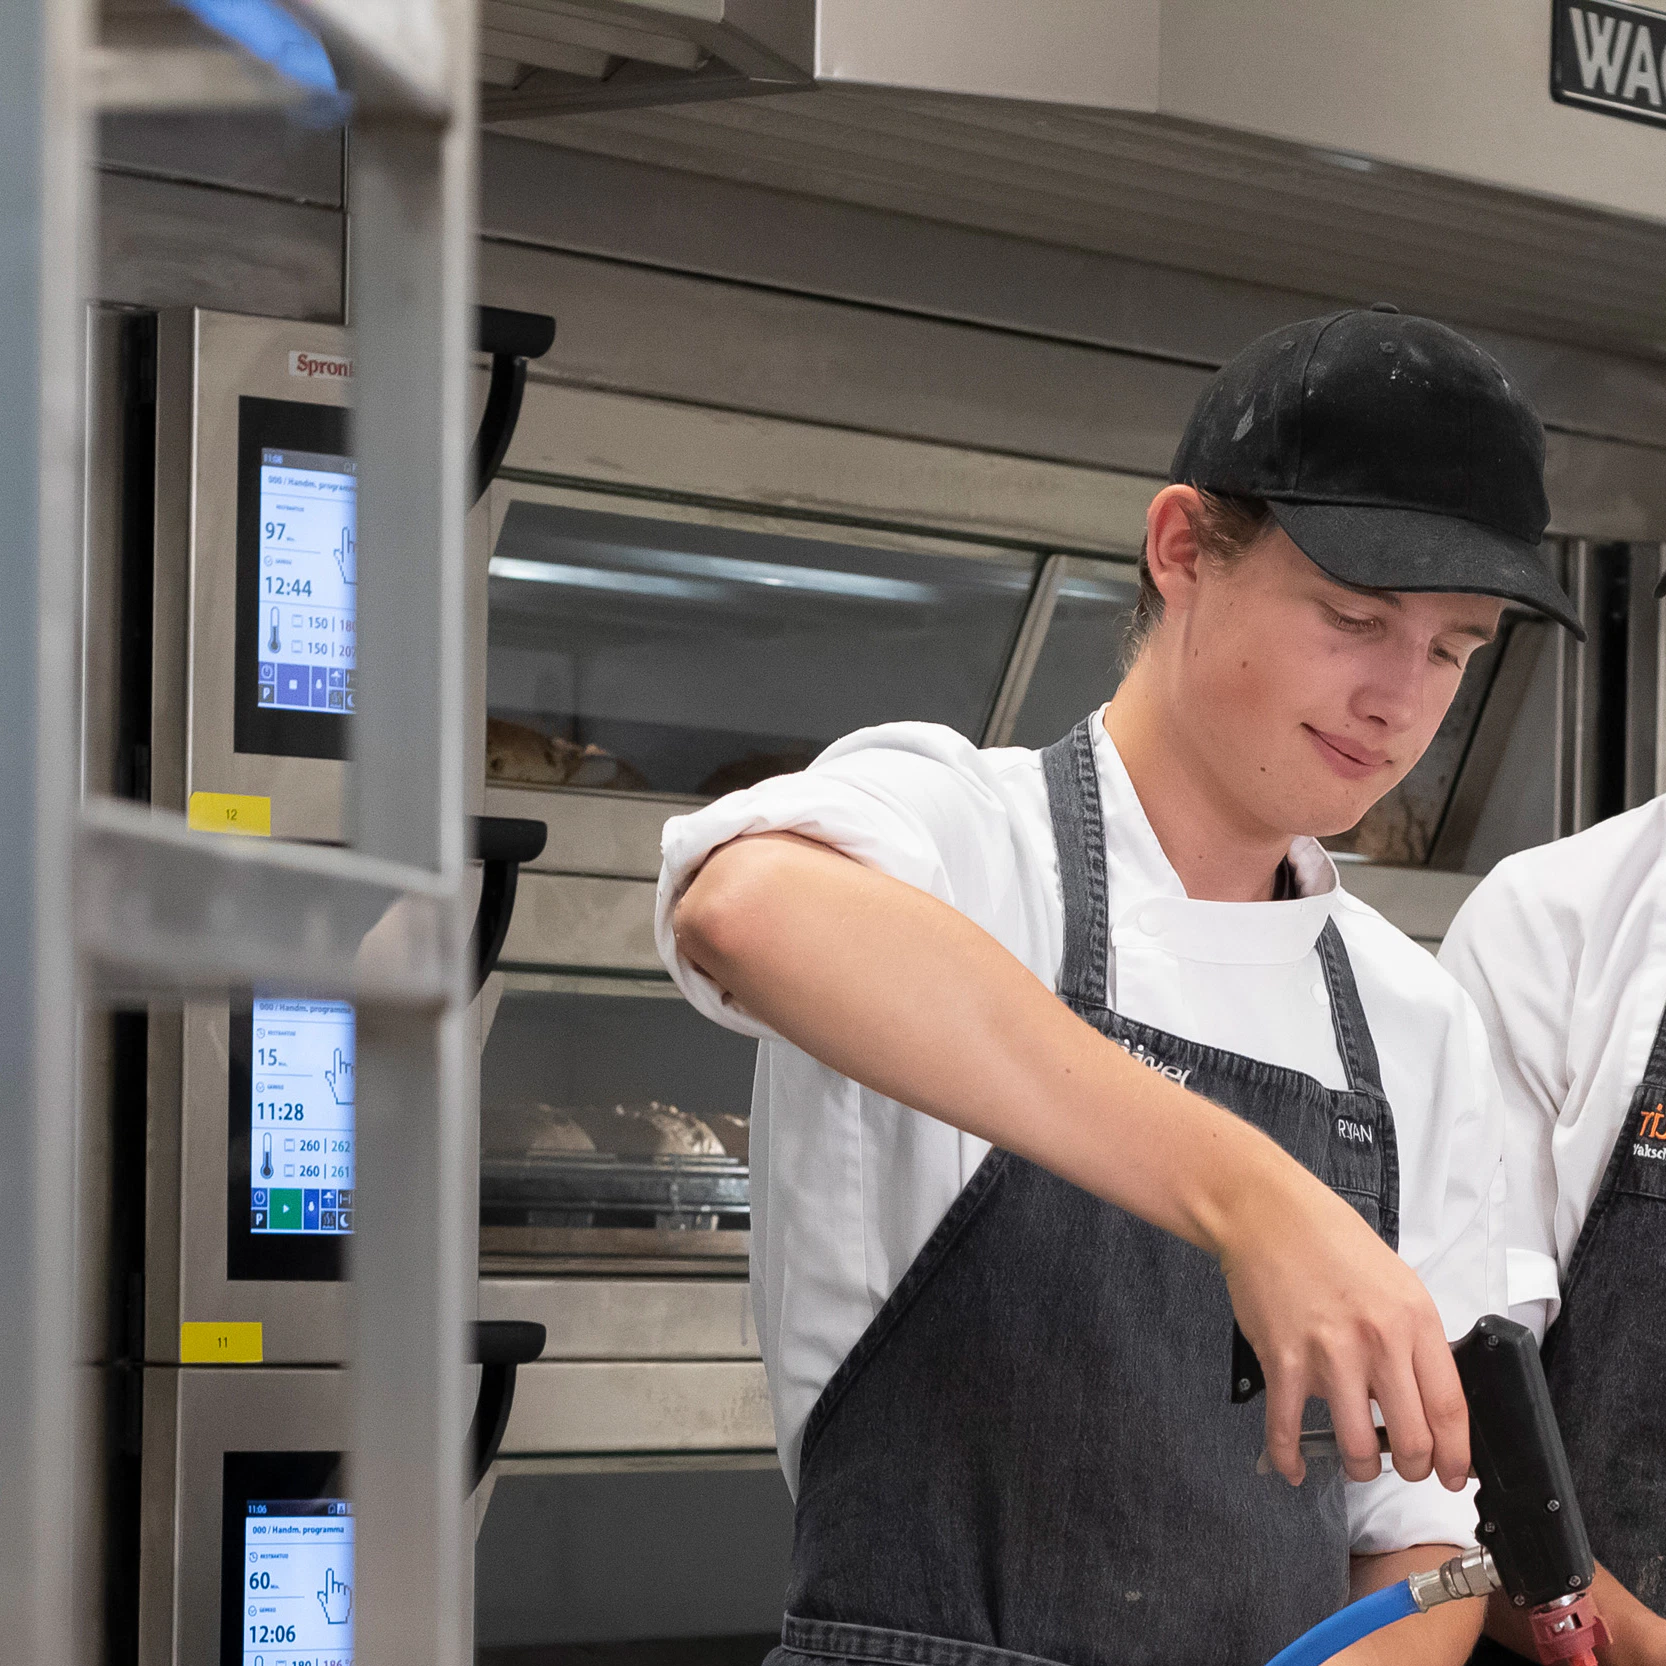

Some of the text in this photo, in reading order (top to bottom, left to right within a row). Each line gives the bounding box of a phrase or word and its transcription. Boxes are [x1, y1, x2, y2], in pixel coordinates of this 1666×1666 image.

[265, 521, 286, 540] 97
[265, 576, 312, 597] 12:44
[308, 616, 328, 629] 150
[308, 642, 328, 655] 150
[226, 808, 238, 821] 12
[258, 1048, 277, 1067] 15
[257, 1102, 305, 1121] 11:28
[1338, 1118, 1373, 1144] RYAN
[299, 1139, 351, 1153] 260 262
[299, 1165, 350, 1178] 260 261
[217, 1336, 228, 1349] 11
[248, 1504, 268, 1514] 11:06
[252, 1526, 266, 1535] 000
[272, 1526, 301, 1534] Handm.
[302, 1526, 345, 1536] programma
[249, 1571, 271, 1590] 60
[249, 1625, 296, 1643] 12:06
